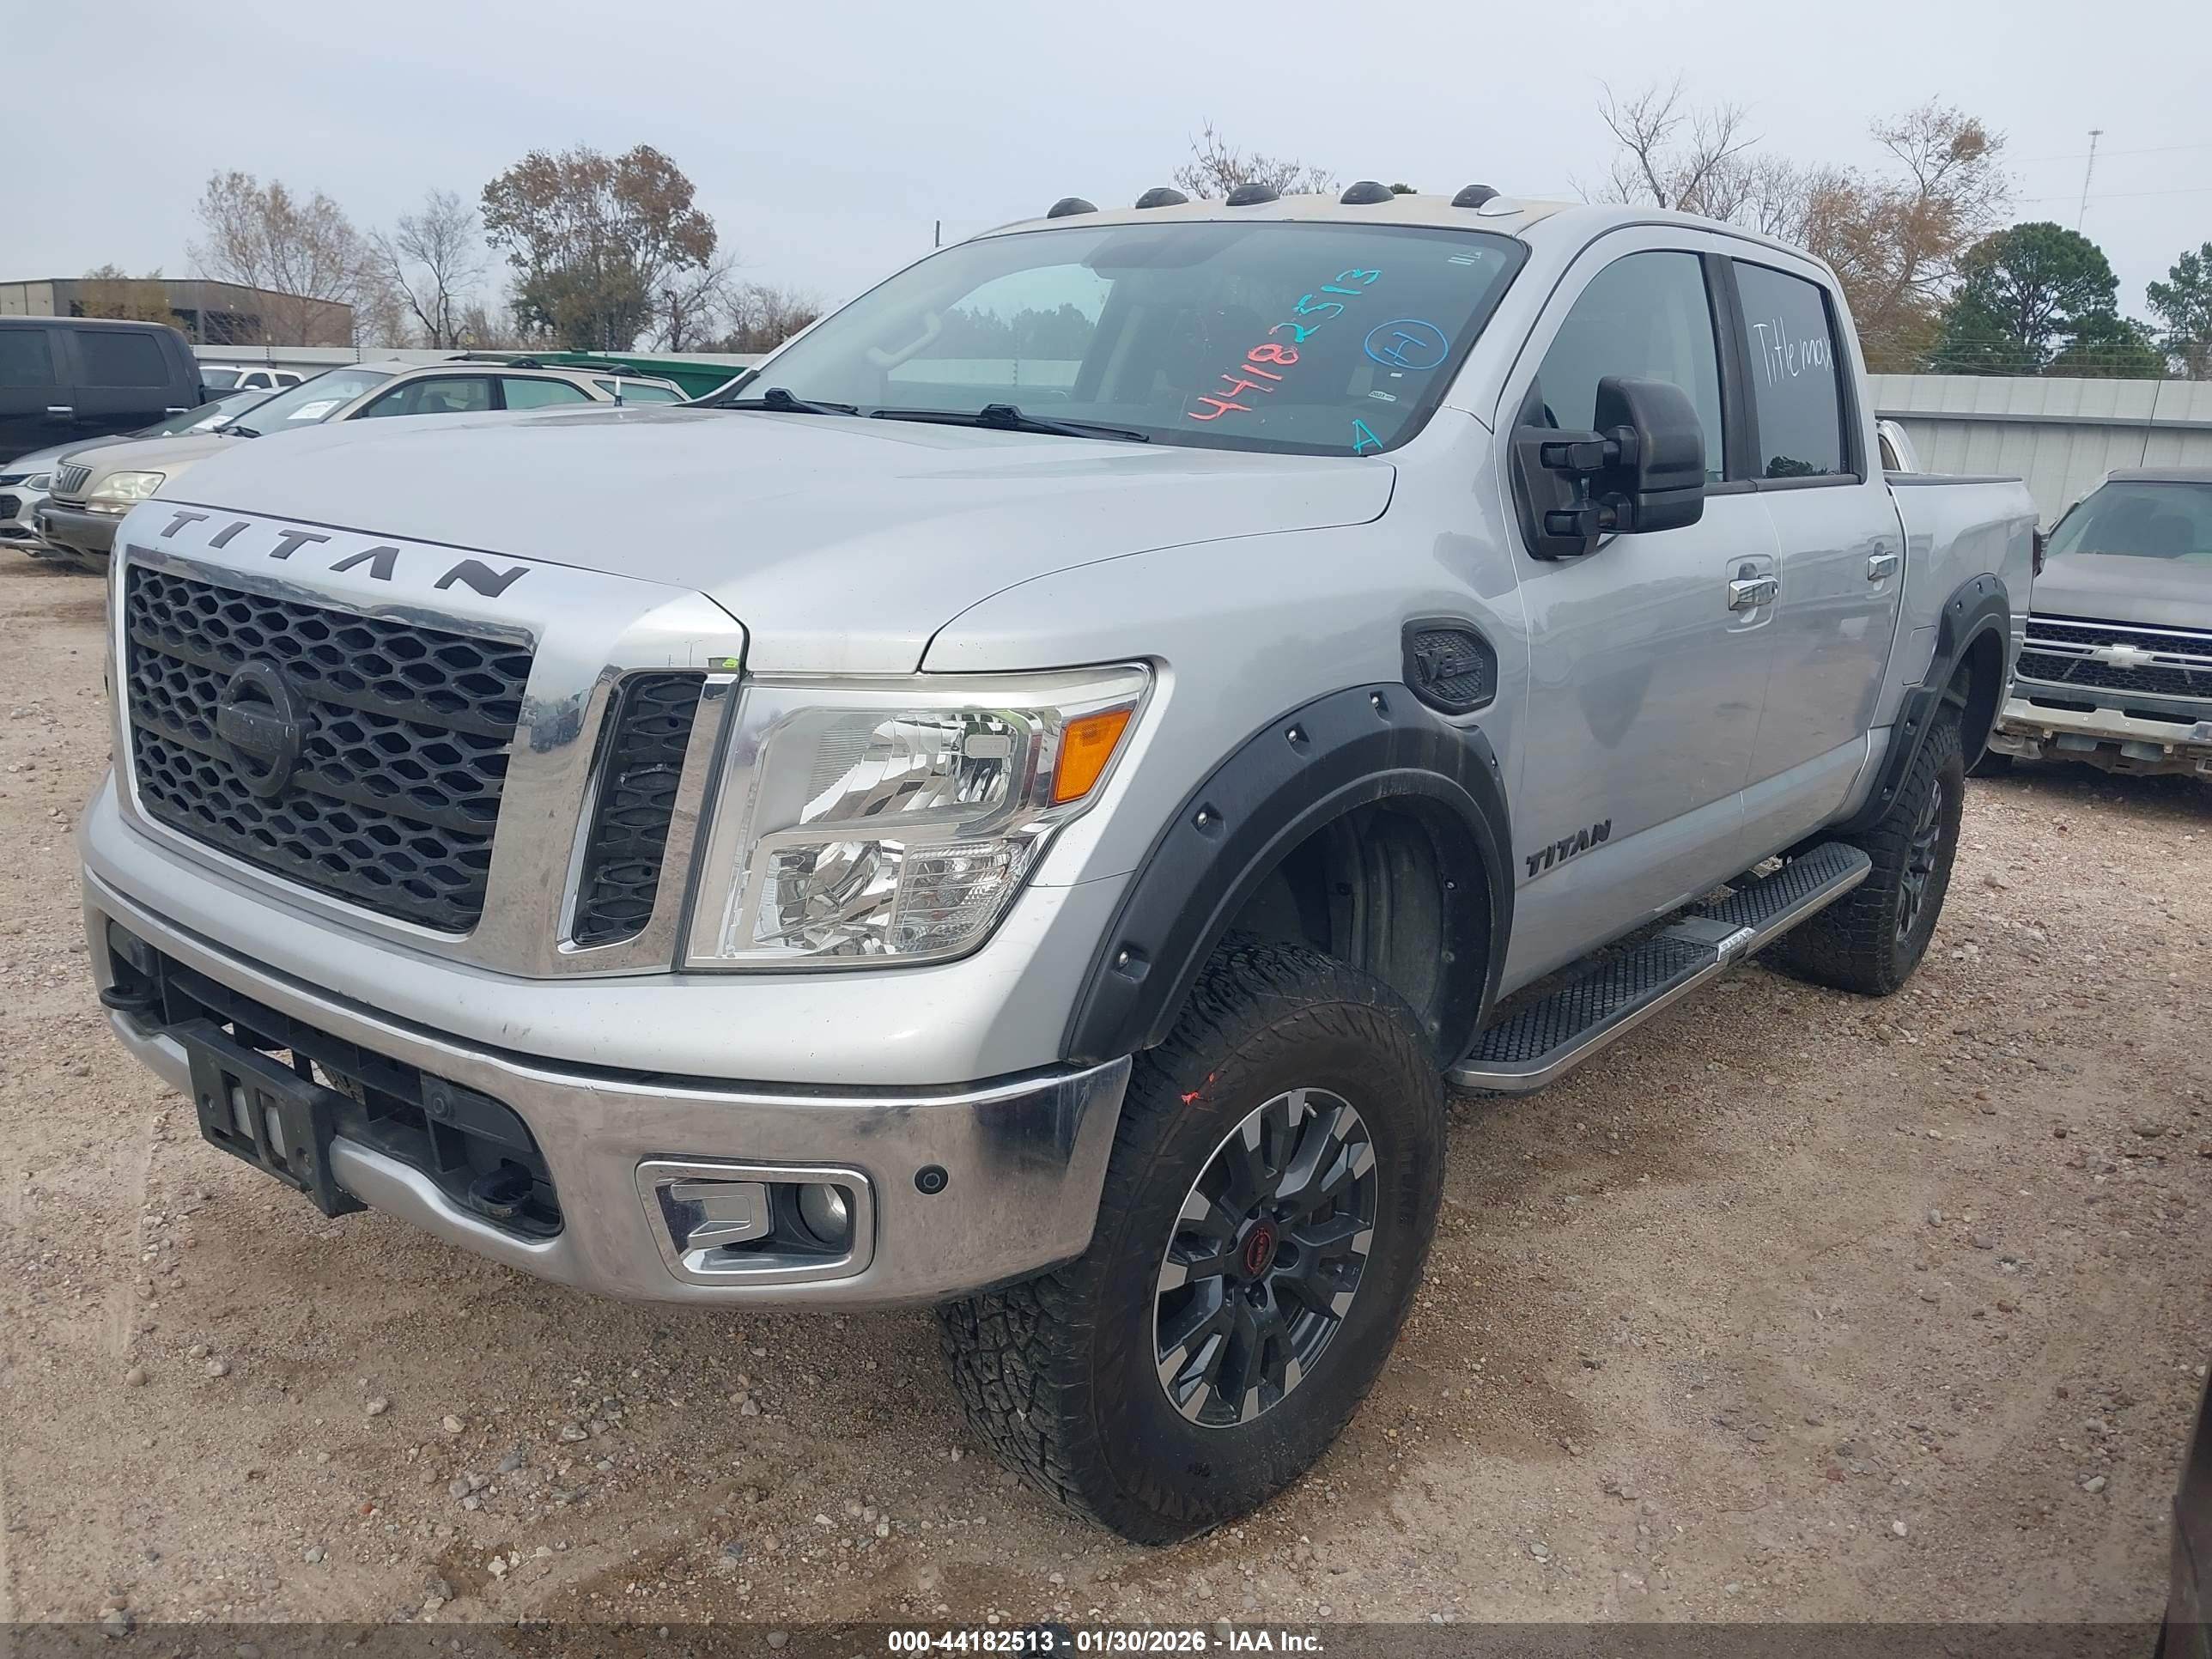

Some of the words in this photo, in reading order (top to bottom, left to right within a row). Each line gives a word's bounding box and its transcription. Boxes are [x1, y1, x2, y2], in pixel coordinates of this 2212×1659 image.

[1188, 268, 1381, 420] 44182513
[1352, 418, 1384, 454] A
[161, 510, 531, 598] TITAN
[1415, 648, 1457, 684] V8
[1526, 817, 1612, 878] TITAN
